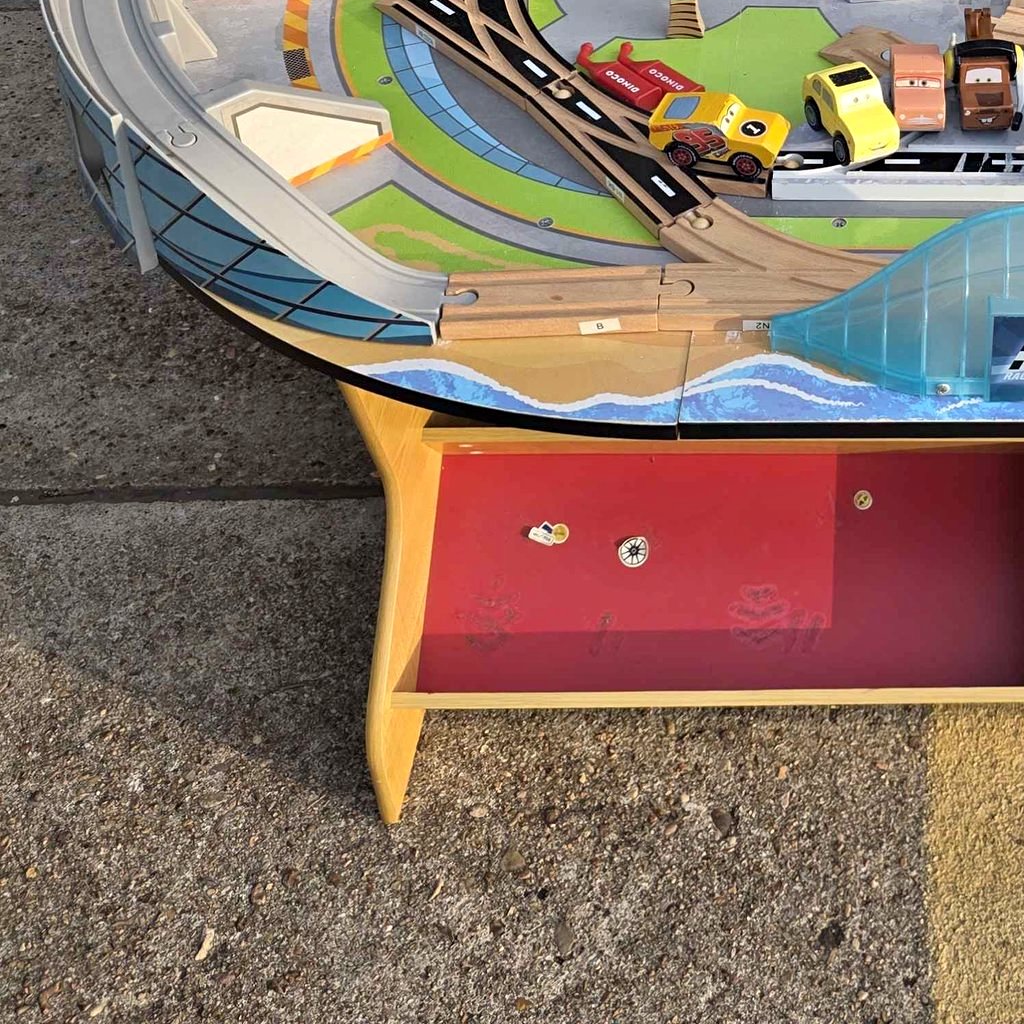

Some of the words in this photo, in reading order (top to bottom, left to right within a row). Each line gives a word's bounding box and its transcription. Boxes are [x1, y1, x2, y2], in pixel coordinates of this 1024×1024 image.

[605, 70, 640, 93] DINOCO
[648, 68, 685, 91] DINOCO
[673, 127, 726, 154] 95
[746, 124, 761, 135] 1
[755, 322, 770, 330] N2
